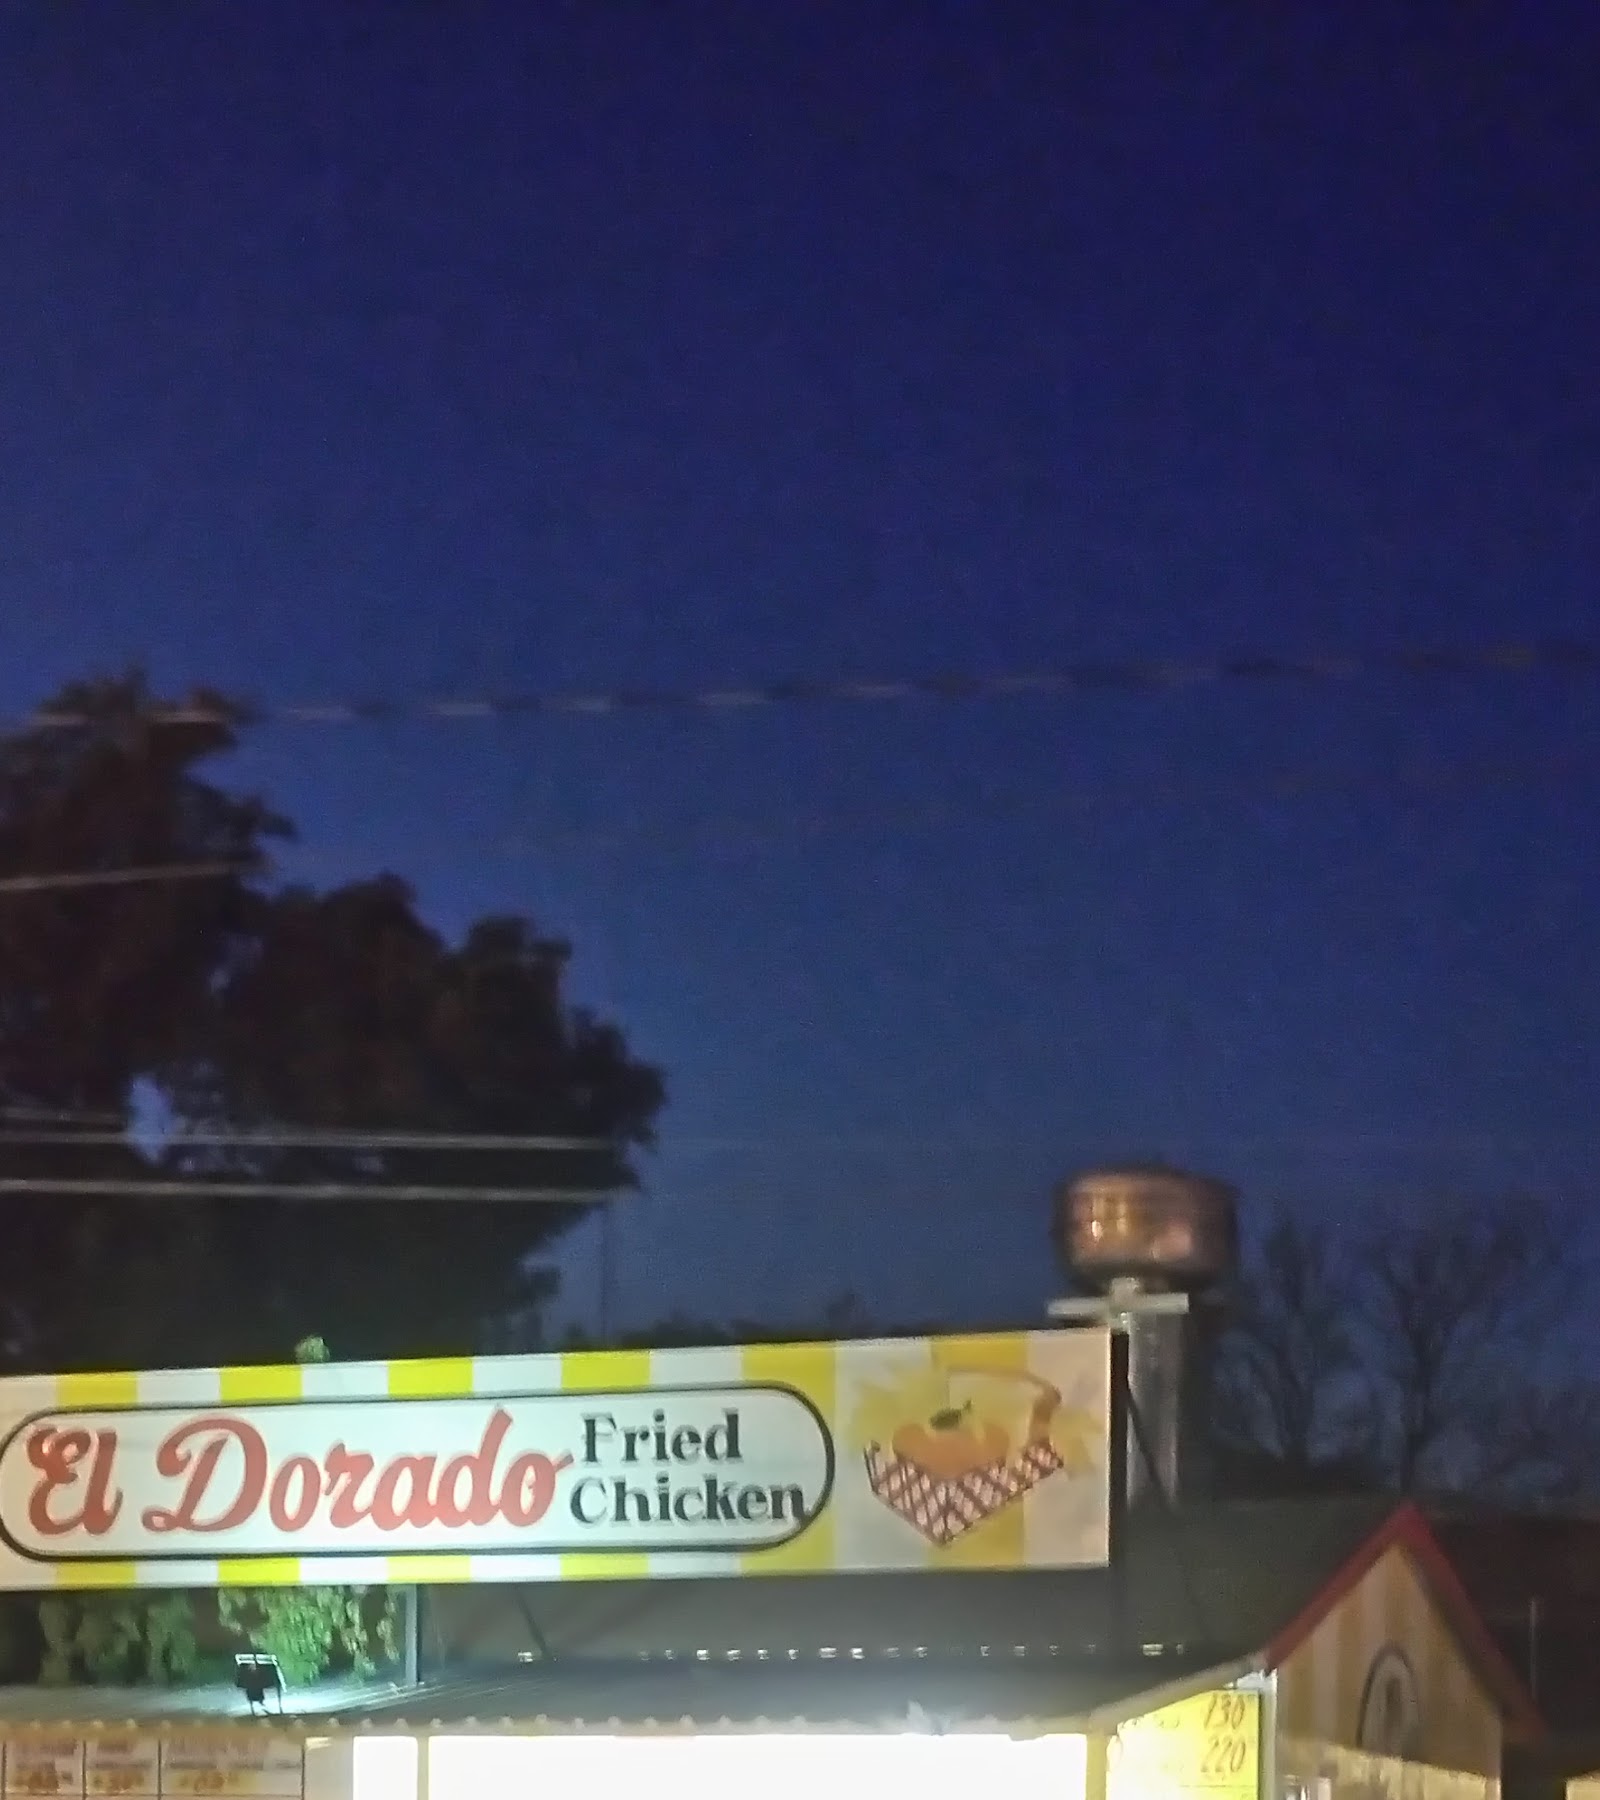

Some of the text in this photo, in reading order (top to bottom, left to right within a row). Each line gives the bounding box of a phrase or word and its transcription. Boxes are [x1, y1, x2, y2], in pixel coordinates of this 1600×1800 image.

[581, 1407, 744, 1464] Fried
[26, 1404, 574, 1536] El Dorado
[569, 1470, 806, 1529] Chicken
